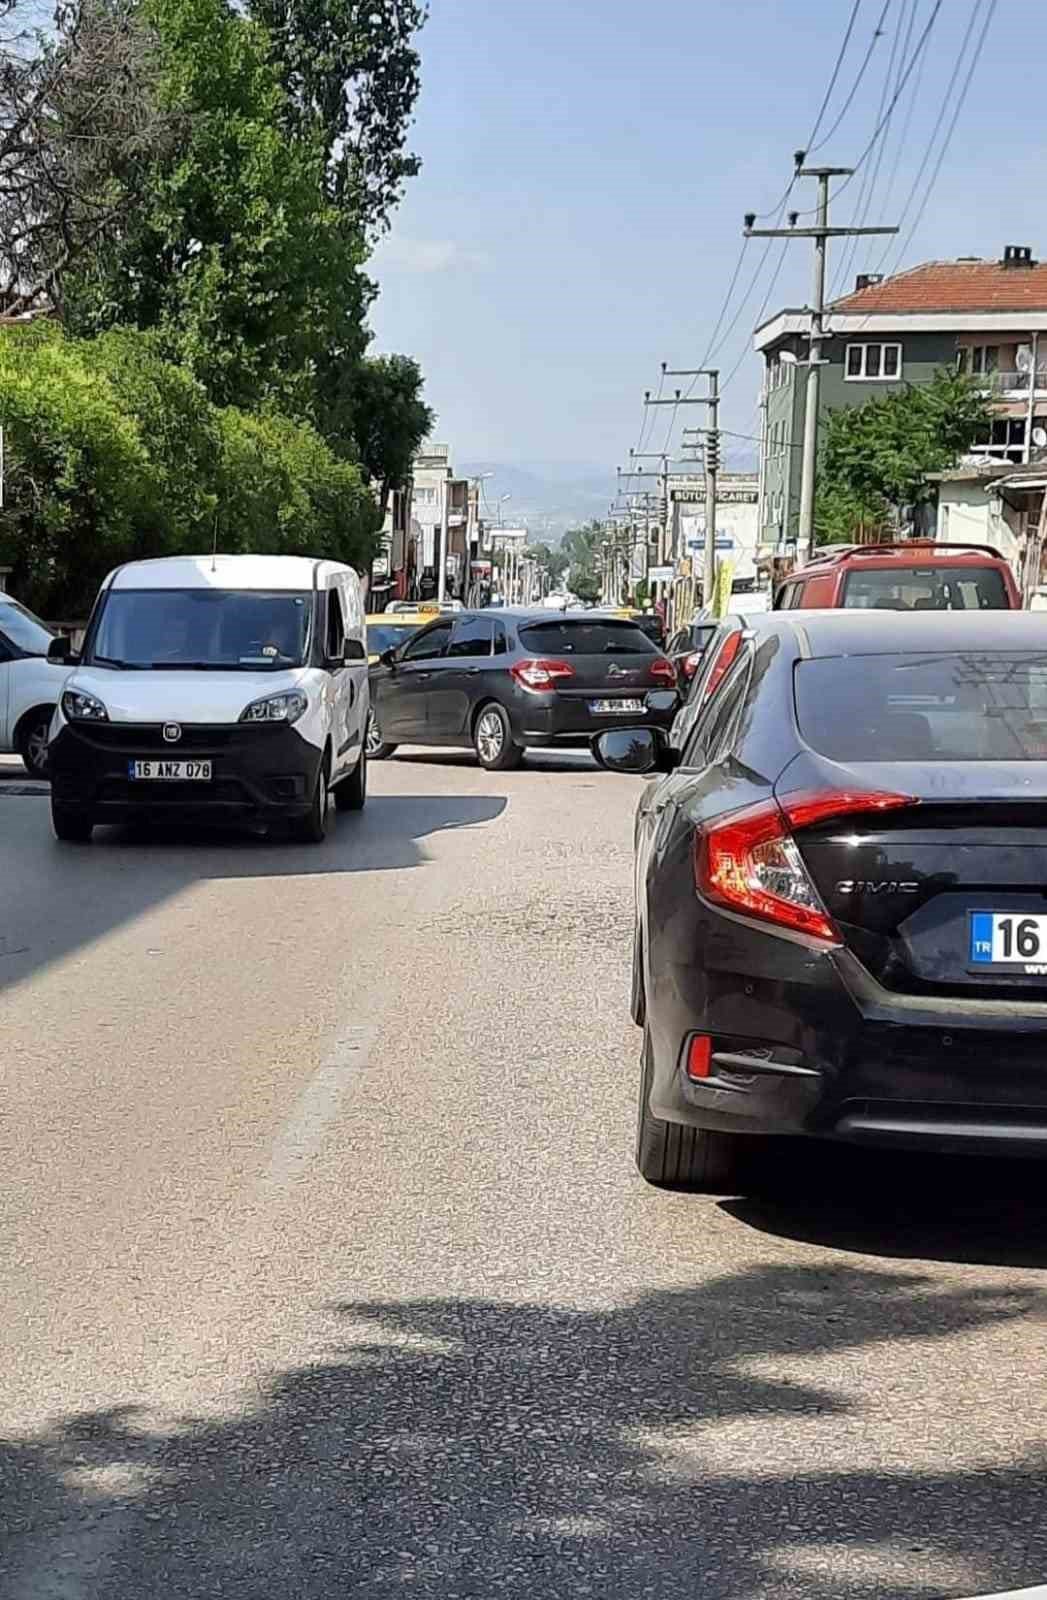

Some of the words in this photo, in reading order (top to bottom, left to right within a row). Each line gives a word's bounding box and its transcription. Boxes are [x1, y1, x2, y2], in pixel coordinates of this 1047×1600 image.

[136, 763, 151, 777] 16
[157, 763, 180, 777] ANZ
[998, 919, 1040, 958] 16
[975, 942, 992, 953] TR
